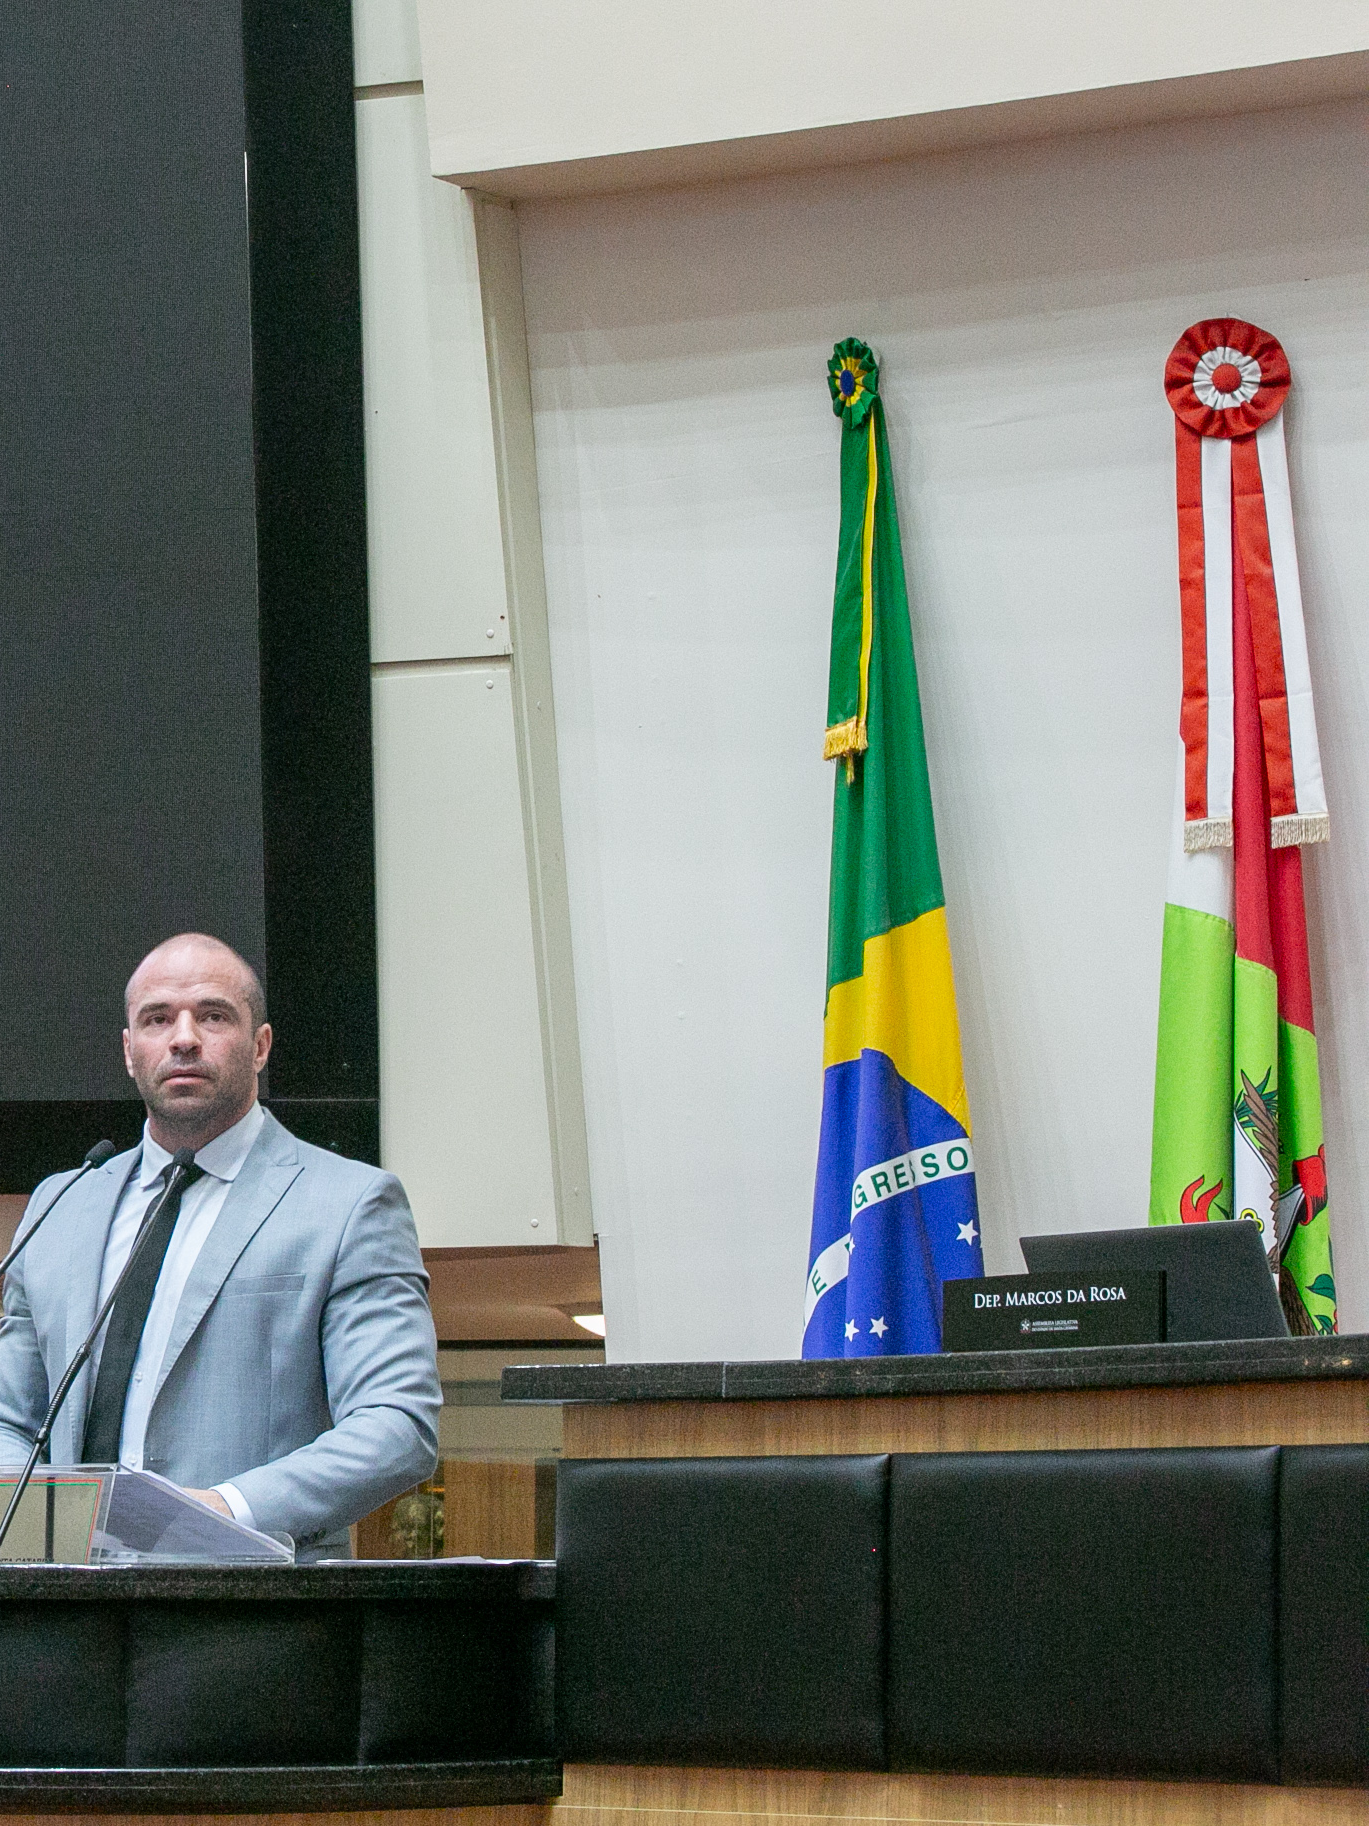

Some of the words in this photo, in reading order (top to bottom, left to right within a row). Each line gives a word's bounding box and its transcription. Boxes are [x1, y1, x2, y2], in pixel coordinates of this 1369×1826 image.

[1005, 1290, 1062, 1306] MARCOS
[1067, 1289, 1086, 1303] DA
[1090, 1286, 1127, 1302] ROSA
